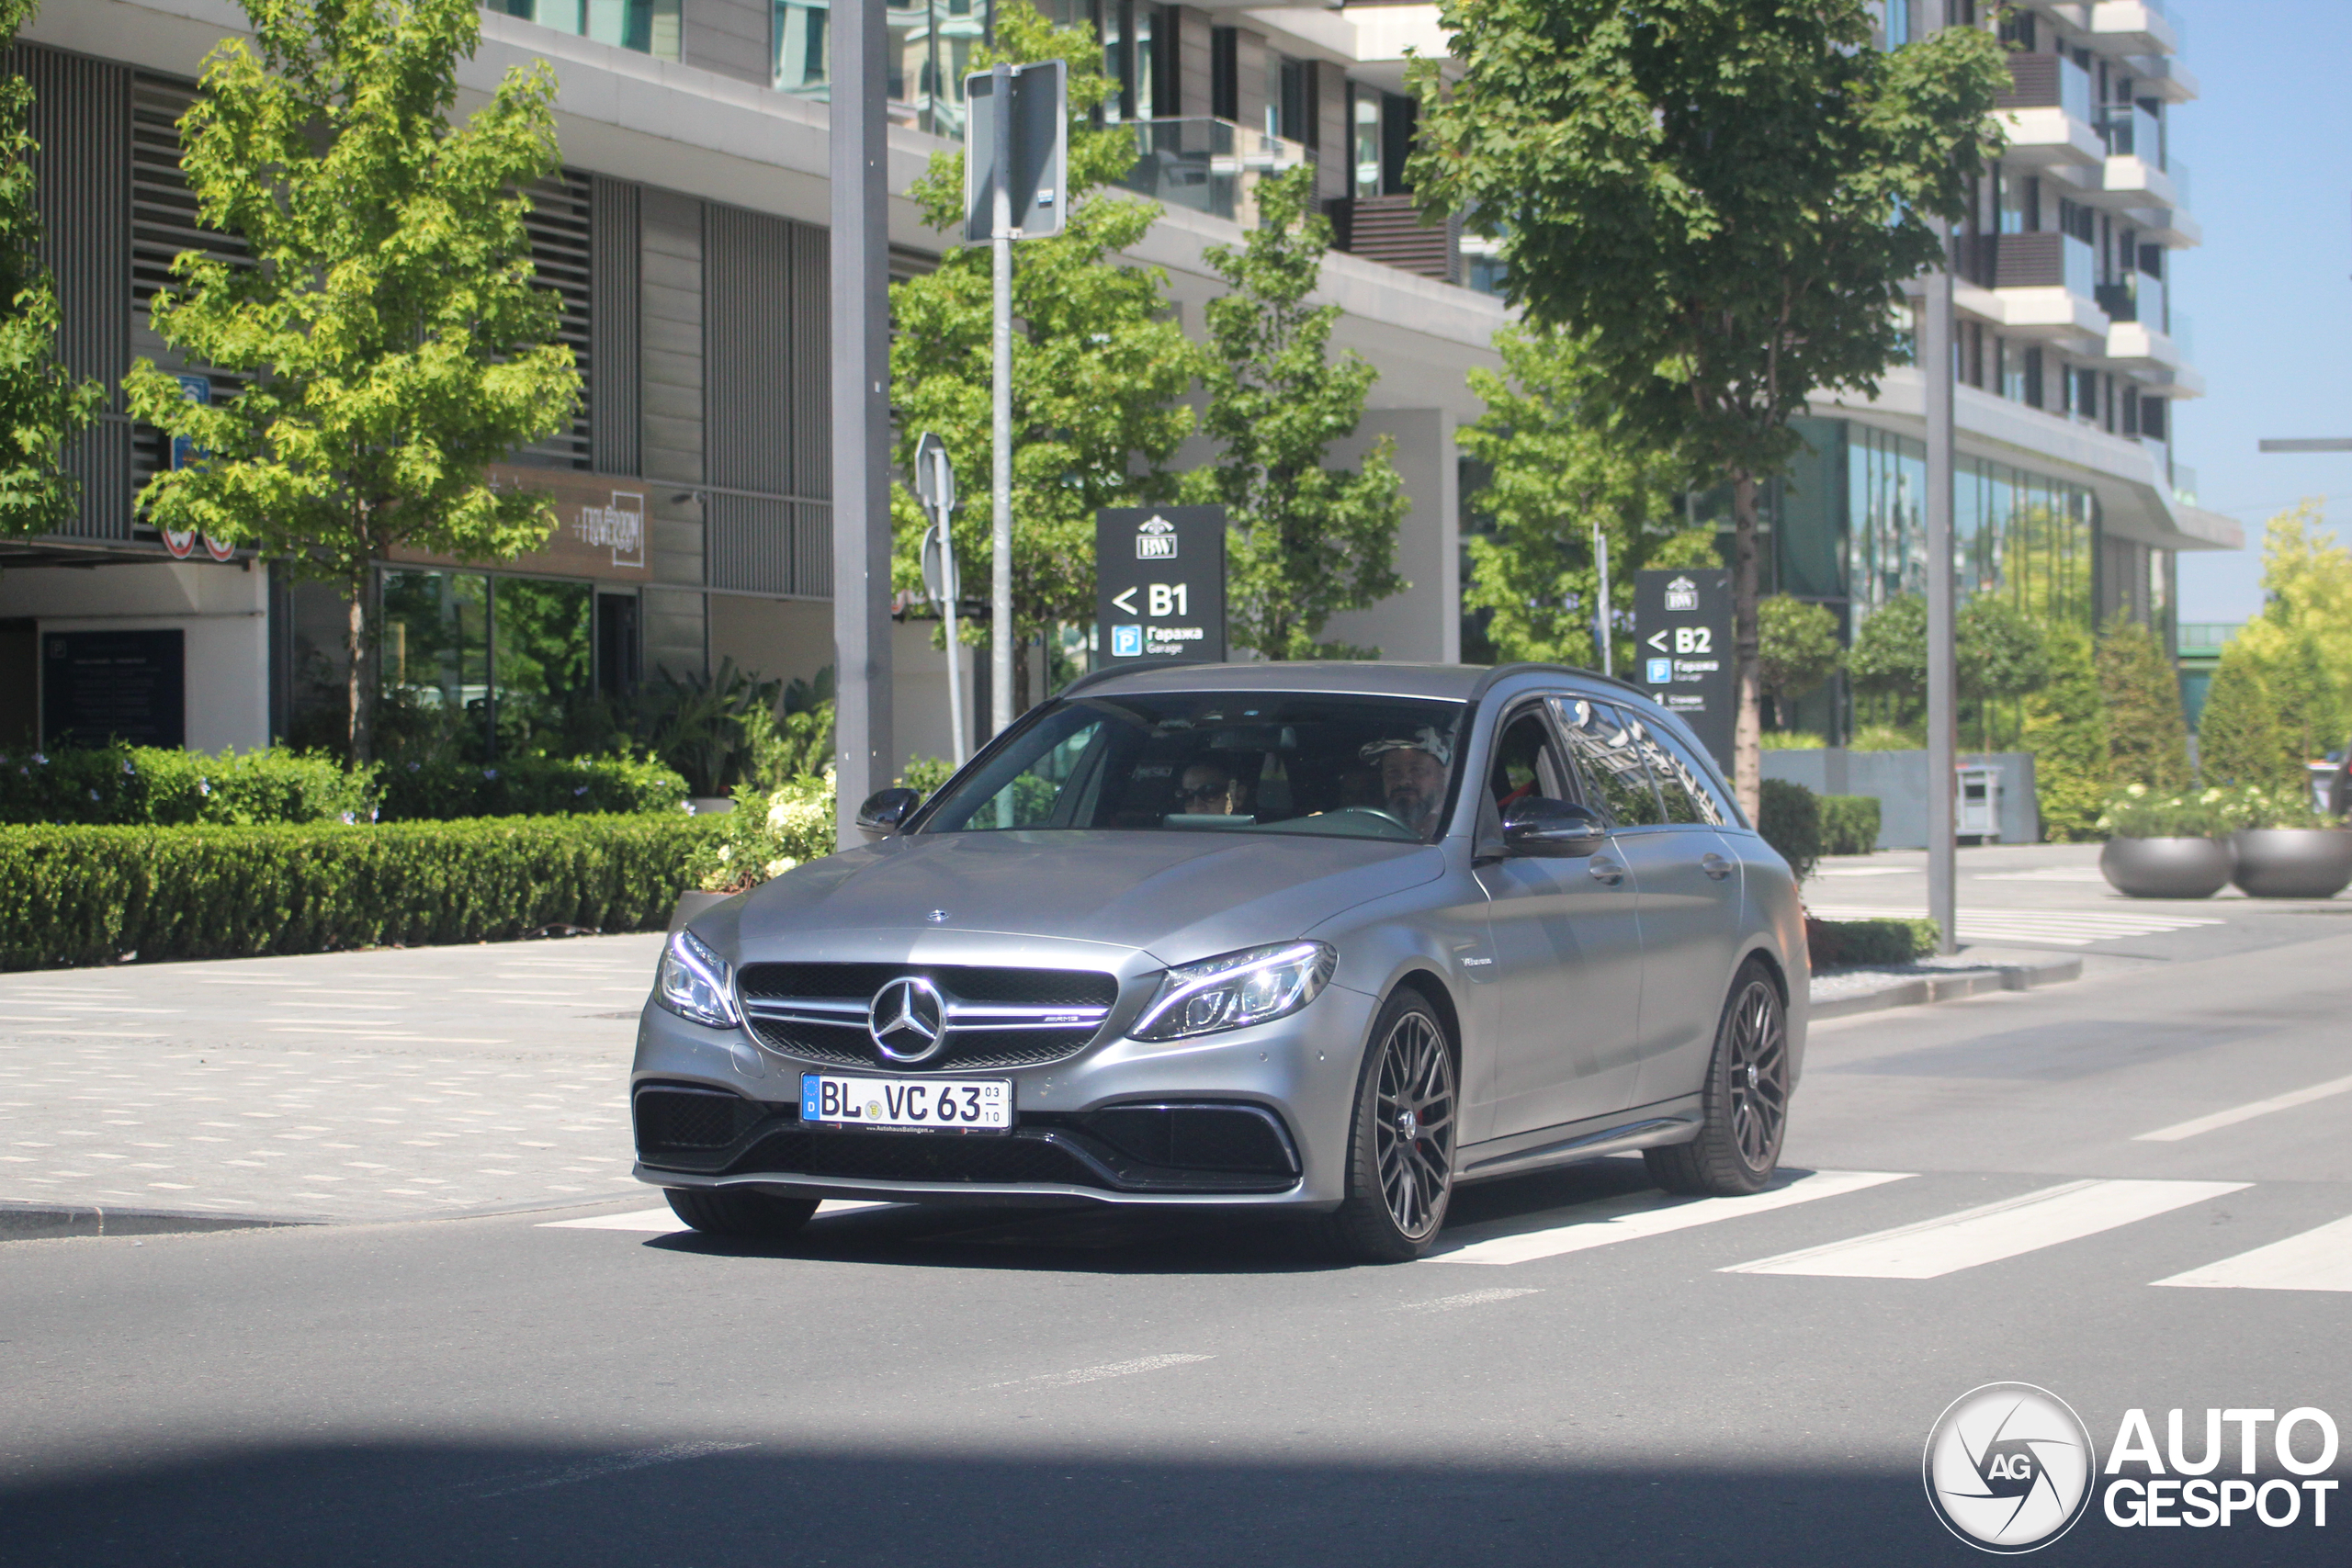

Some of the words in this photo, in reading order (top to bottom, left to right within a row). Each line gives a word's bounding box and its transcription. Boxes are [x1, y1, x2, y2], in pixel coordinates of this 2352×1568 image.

[1141, 537, 1173, 557] BW
[1148, 582, 1187, 616] B1
[1119, 635, 1136, 653] P
[1146, 626, 1204, 643] Гаража
[1146, 642, 1183, 656] Garage
[1675, 626, 1713, 653] B2
[821, 1081, 862, 1118] BL
[885, 1085, 928, 1121] VC
[937, 1087, 980, 1122] 63
[985, 1087, 1000, 1098] 03
[808, 1101, 815, 1112] D
[985, 1111, 1000, 1122] 10
